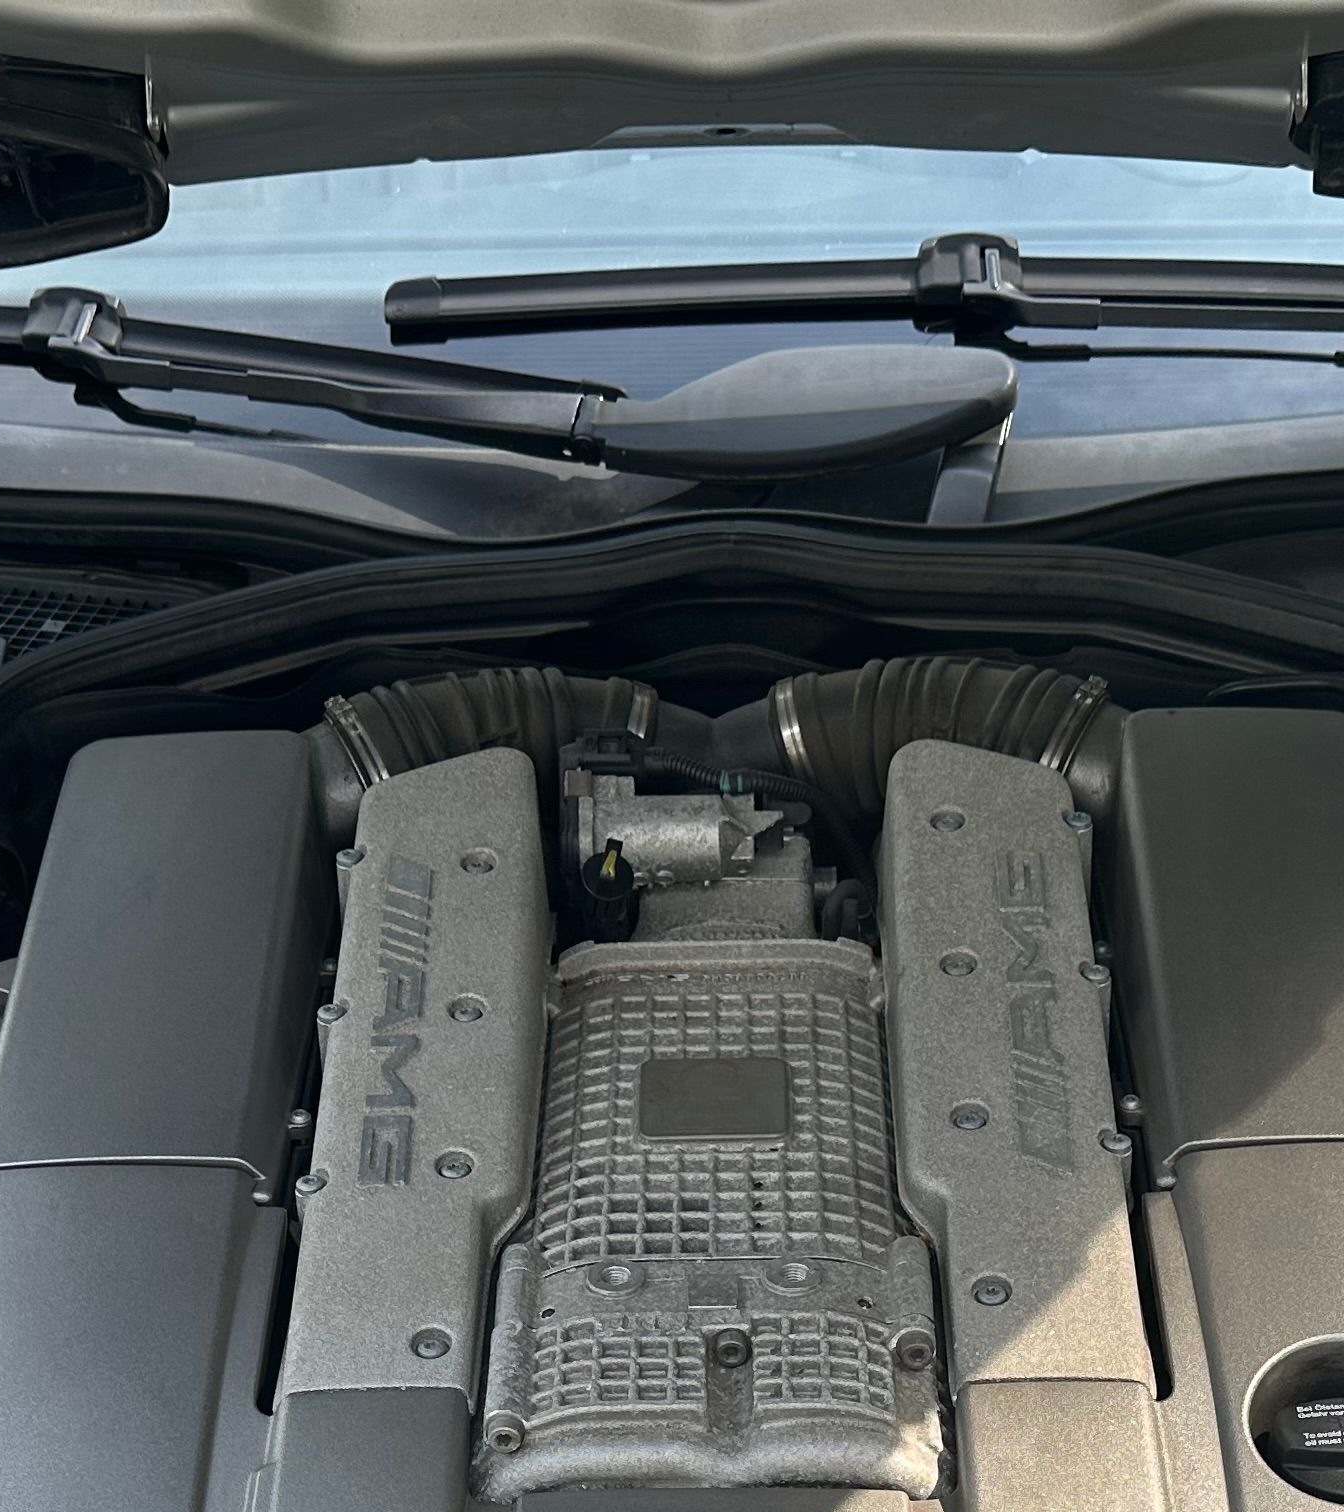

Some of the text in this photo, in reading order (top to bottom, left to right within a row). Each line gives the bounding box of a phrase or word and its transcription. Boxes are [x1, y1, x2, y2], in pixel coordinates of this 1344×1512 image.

[358, 957, 424, 1187] AMG
[1303, 1432, 1315, 1440] To
[1317, 1430, 1342, 1438] avoid
[1318, 1438, 1342, 1446] must
